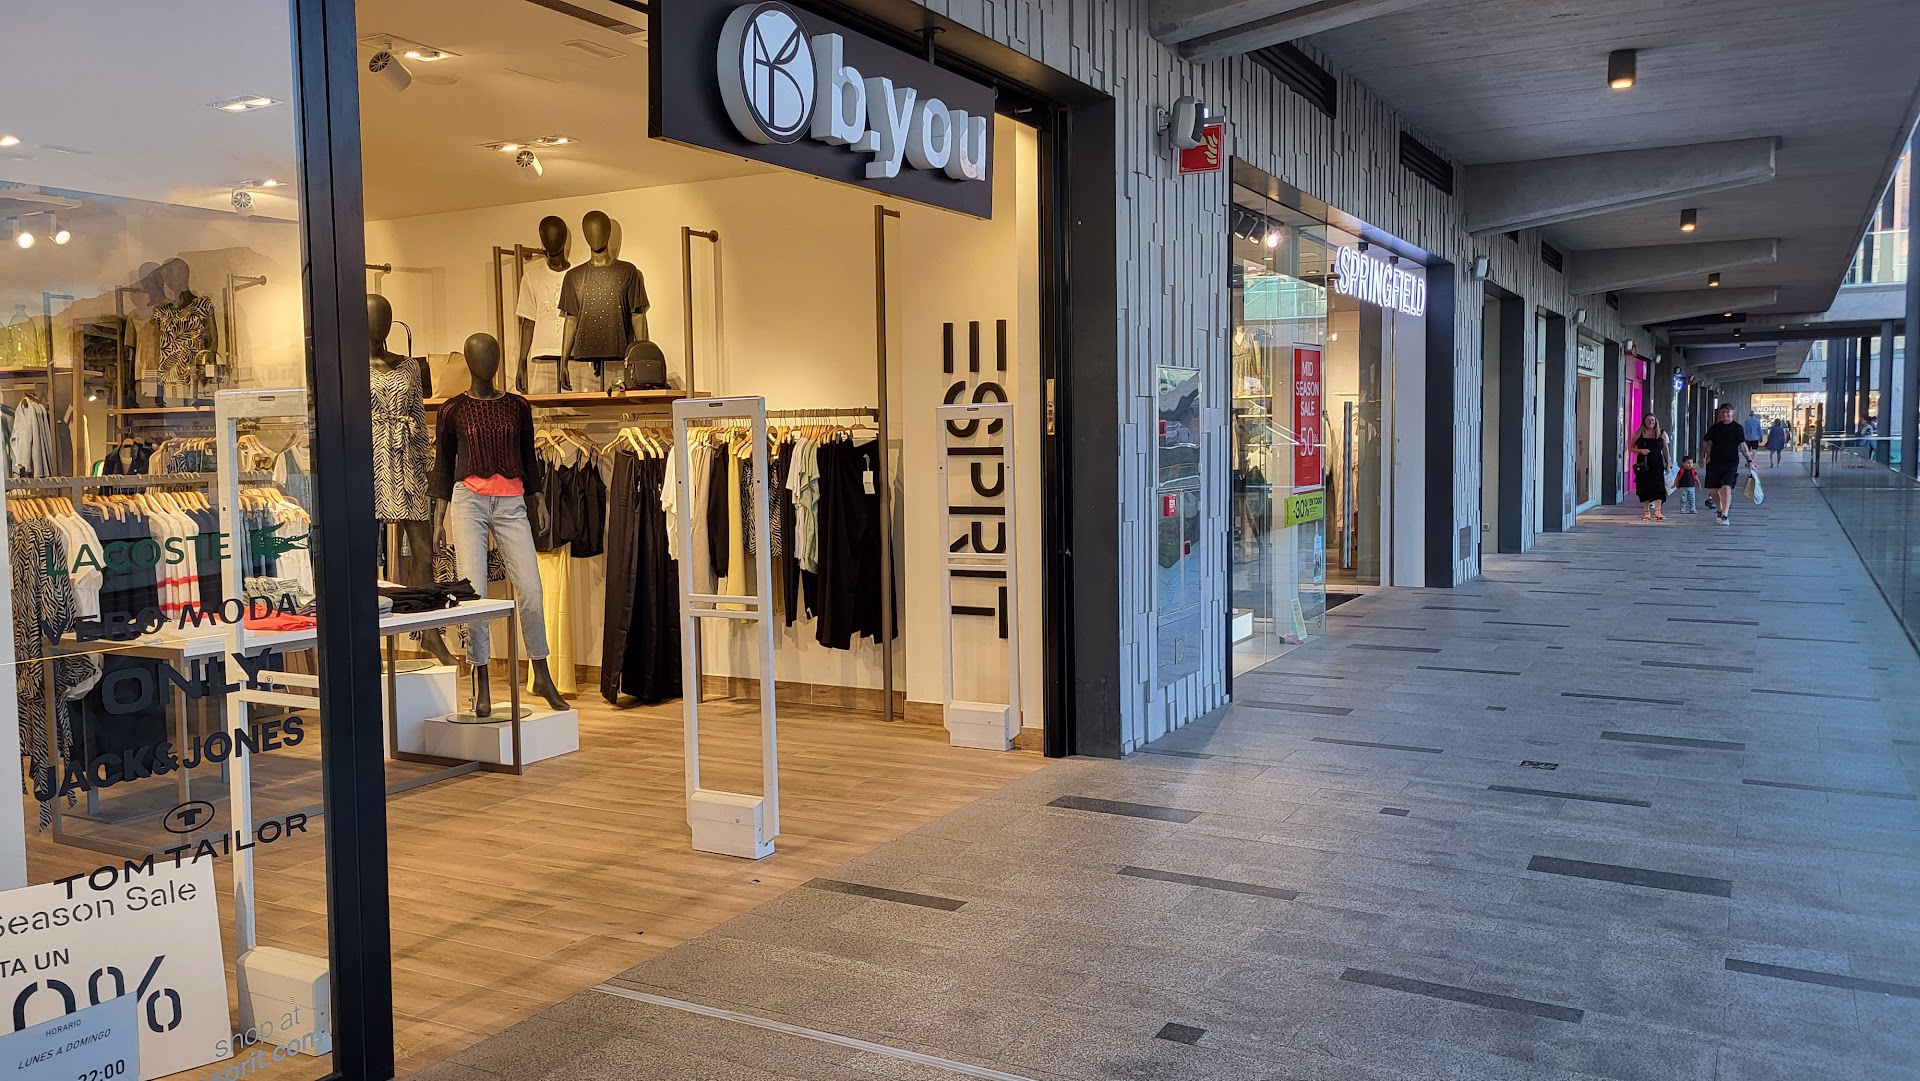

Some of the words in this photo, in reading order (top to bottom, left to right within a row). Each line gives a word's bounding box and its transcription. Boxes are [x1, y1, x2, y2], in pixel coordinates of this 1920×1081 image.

[1334, 246, 1425, 316] SPRINGFIELD
[1295, 381, 1319, 397] SEASON
[1302, 361, 1314, 376] MID
[1300, 401, 1315, 416] SALE
[943, 319, 1009, 639] ESPRIT
[44, 533, 232, 577] LACOSTE
[40, 606, 165, 646] VERO
[178, 593, 298, 632] MODA
[101, 648, 273, 715] ONLY
[34, 716, 305, 802] JACK&JONES
[54, 853, 155, 900] TOM
[164, 813, 308, 869] TAILOR
[126, 880, 197, 911] Sale
[34, 948, 70, 970] UN
[18, 1049, 54, 1070] LUNES
[55, 1046, 63, 1056] A
[65, 1028, 111, 1053] DOMINGO
[45, 1019, 82, 1037] HORARIO
[215, 1021, 274, 1058] shop
[280, 1006, 301, 1031] at
